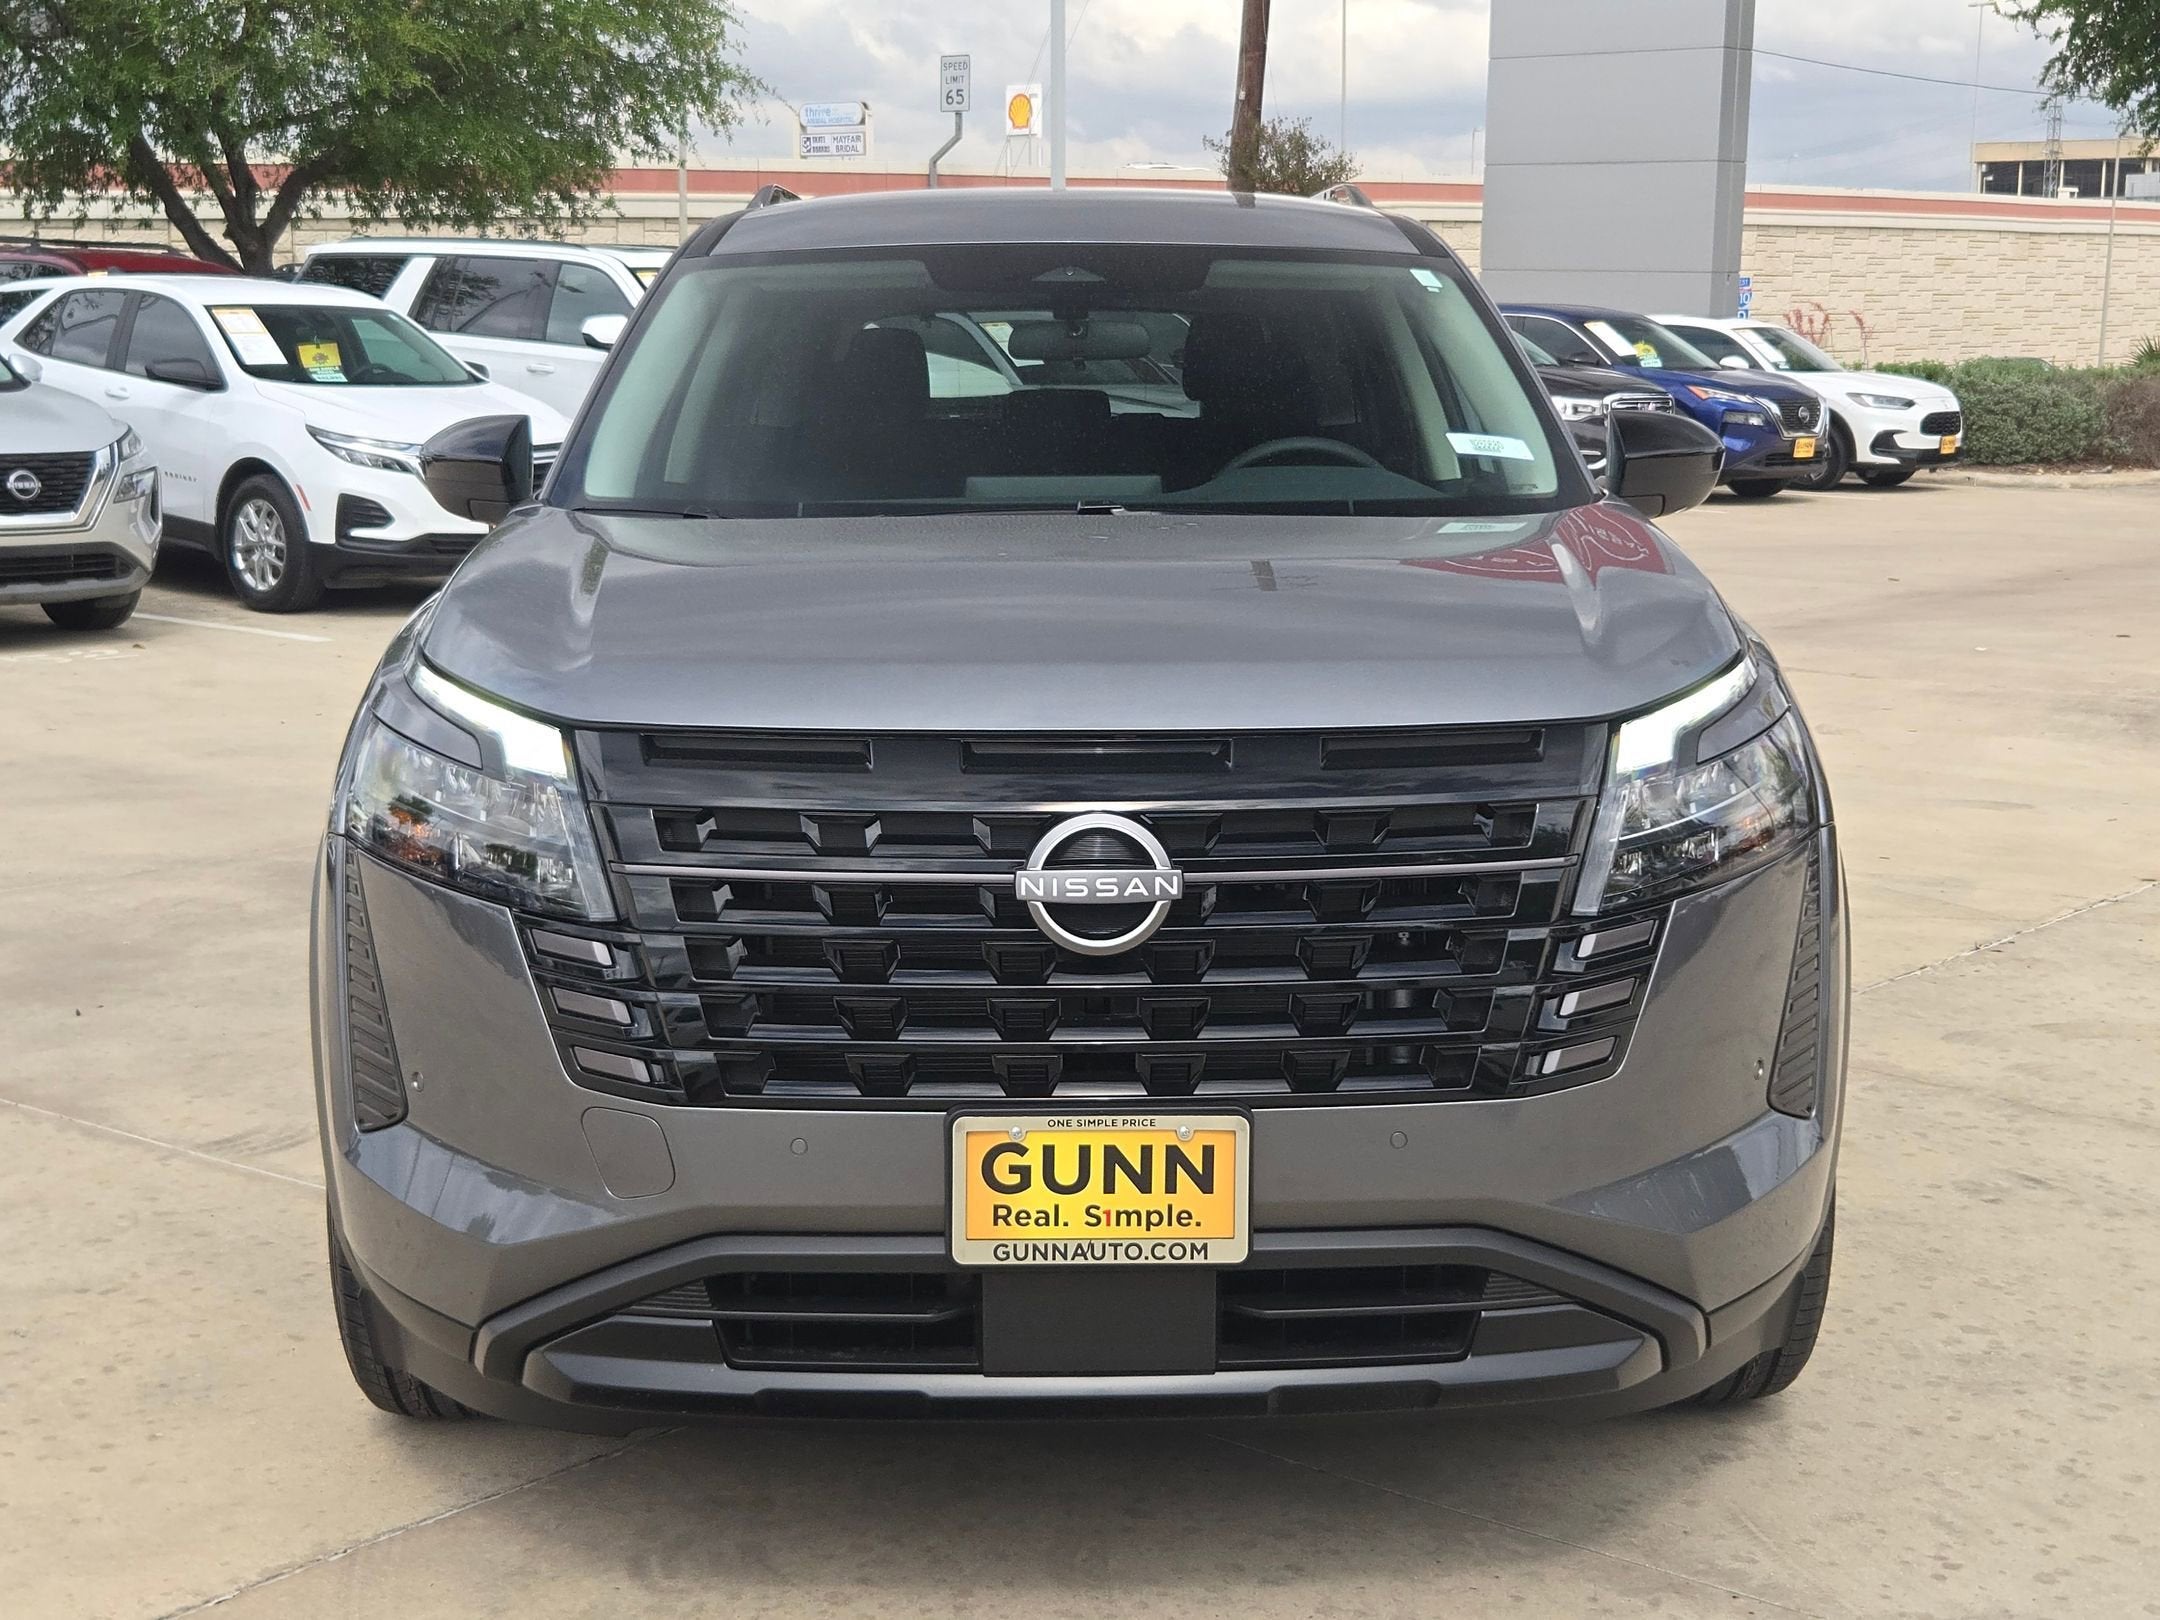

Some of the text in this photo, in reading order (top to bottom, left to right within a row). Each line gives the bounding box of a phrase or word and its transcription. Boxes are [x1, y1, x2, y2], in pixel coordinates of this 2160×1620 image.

[943, 61, 968, 71] SPEED
[945, 75, 965, 84] LIMIT
[945, 89, 965, 106] 65
[832, 135, 861, 144] MAYFAIR
[836, 145, 859, 153] BRIDAL
[1020, 875, 1178, 897] NISSAN
[1047, 1118, 1156, 1128] ONE SIMPLE PRICE
[981, 1141, 1215, 1195] GUNN
[992, 1204, 1069, 1227] Real.
[992, 1241, 1209, 1262] GUNNAUTO.COM
